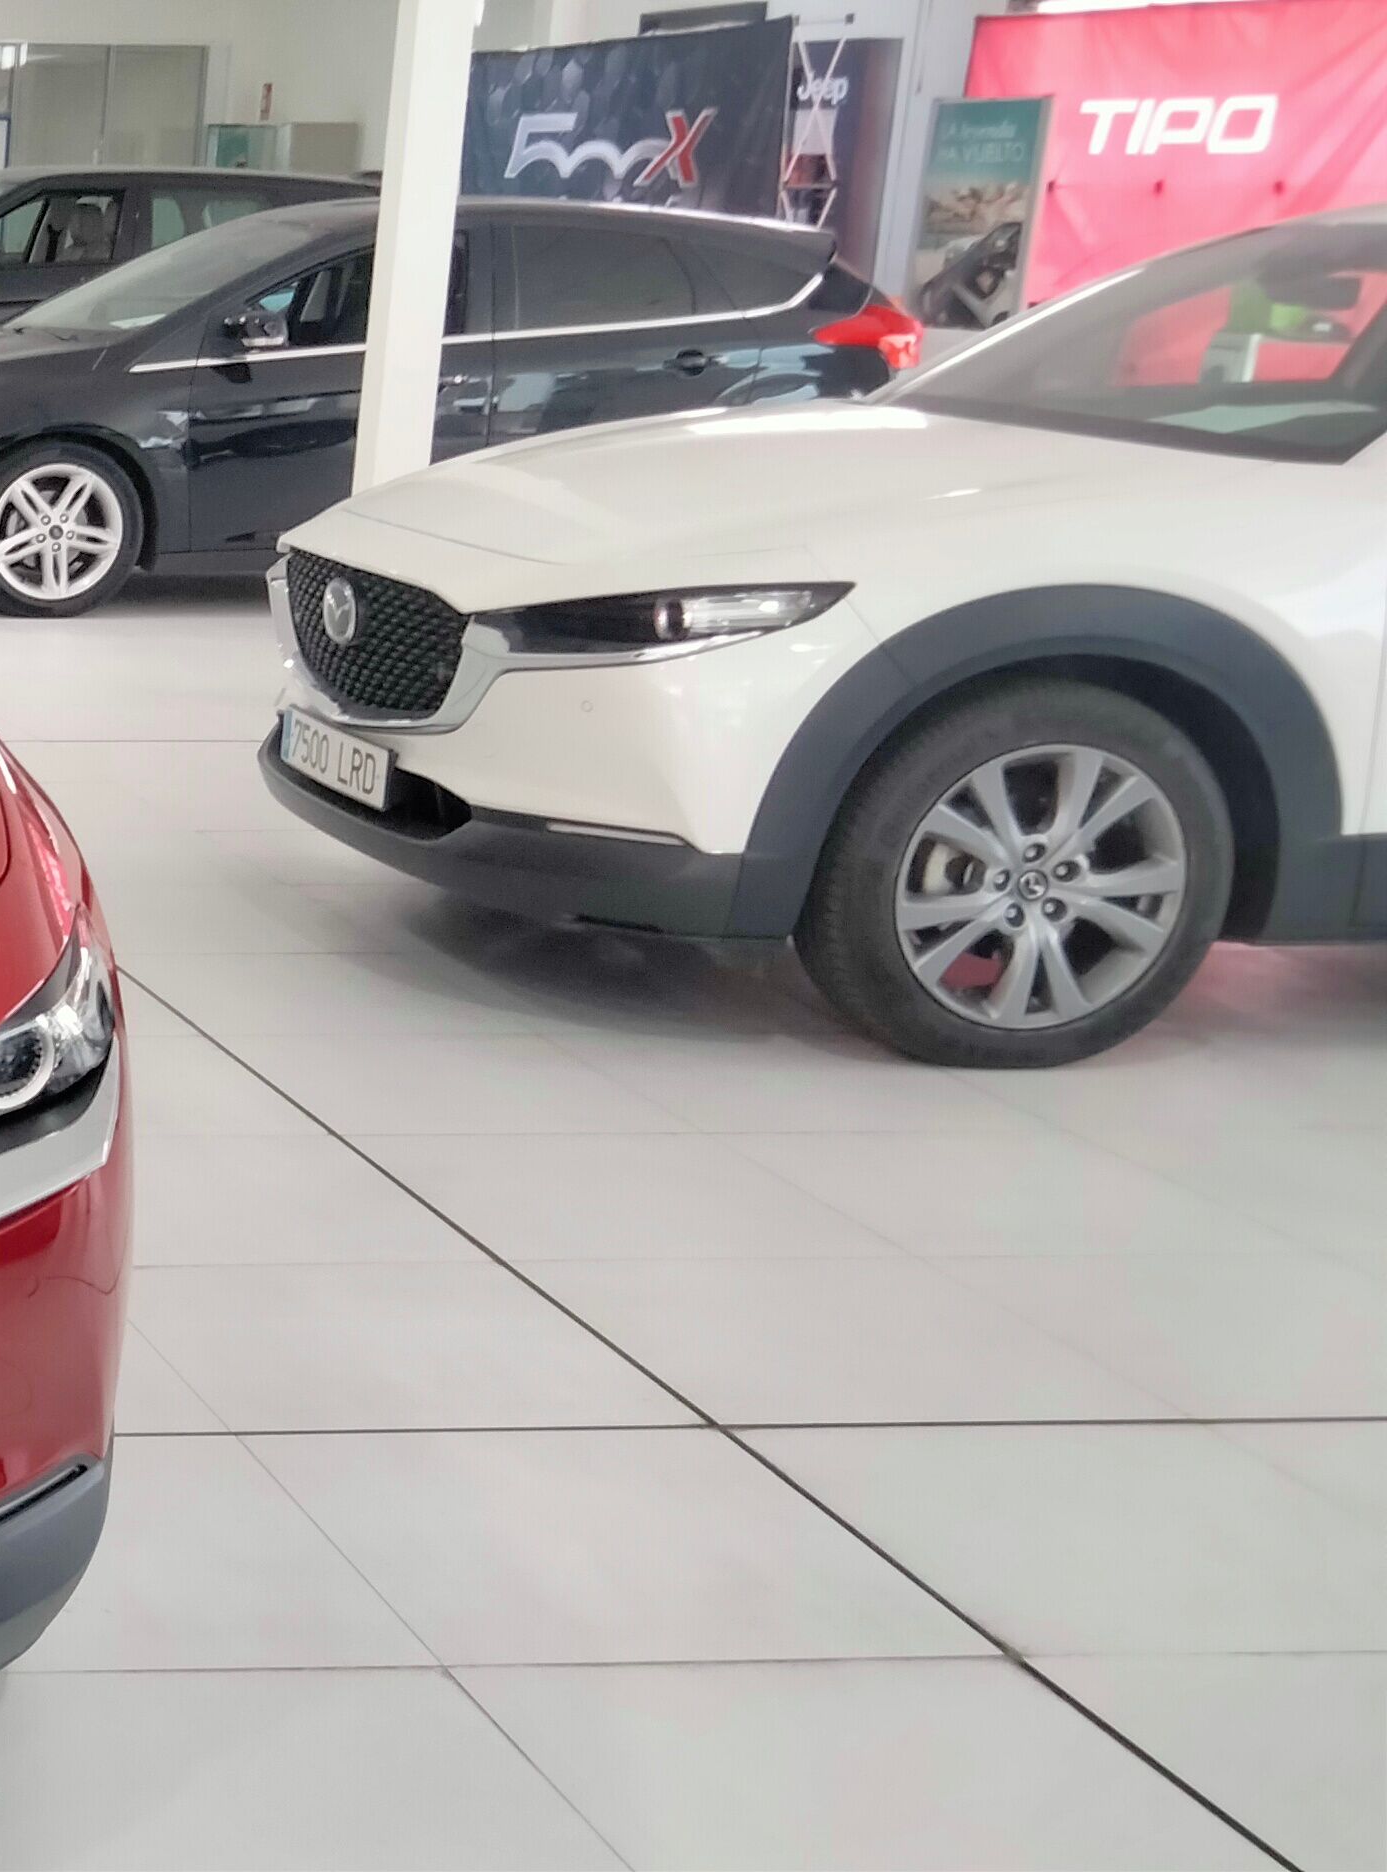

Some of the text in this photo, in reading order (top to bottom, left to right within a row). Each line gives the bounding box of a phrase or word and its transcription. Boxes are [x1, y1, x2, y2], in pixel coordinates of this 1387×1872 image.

[797, 75, 848, 105] Jeep
[1080, 94, 1278, 155] TIPO
[292, 719, 376, 795] 7500 LRD
